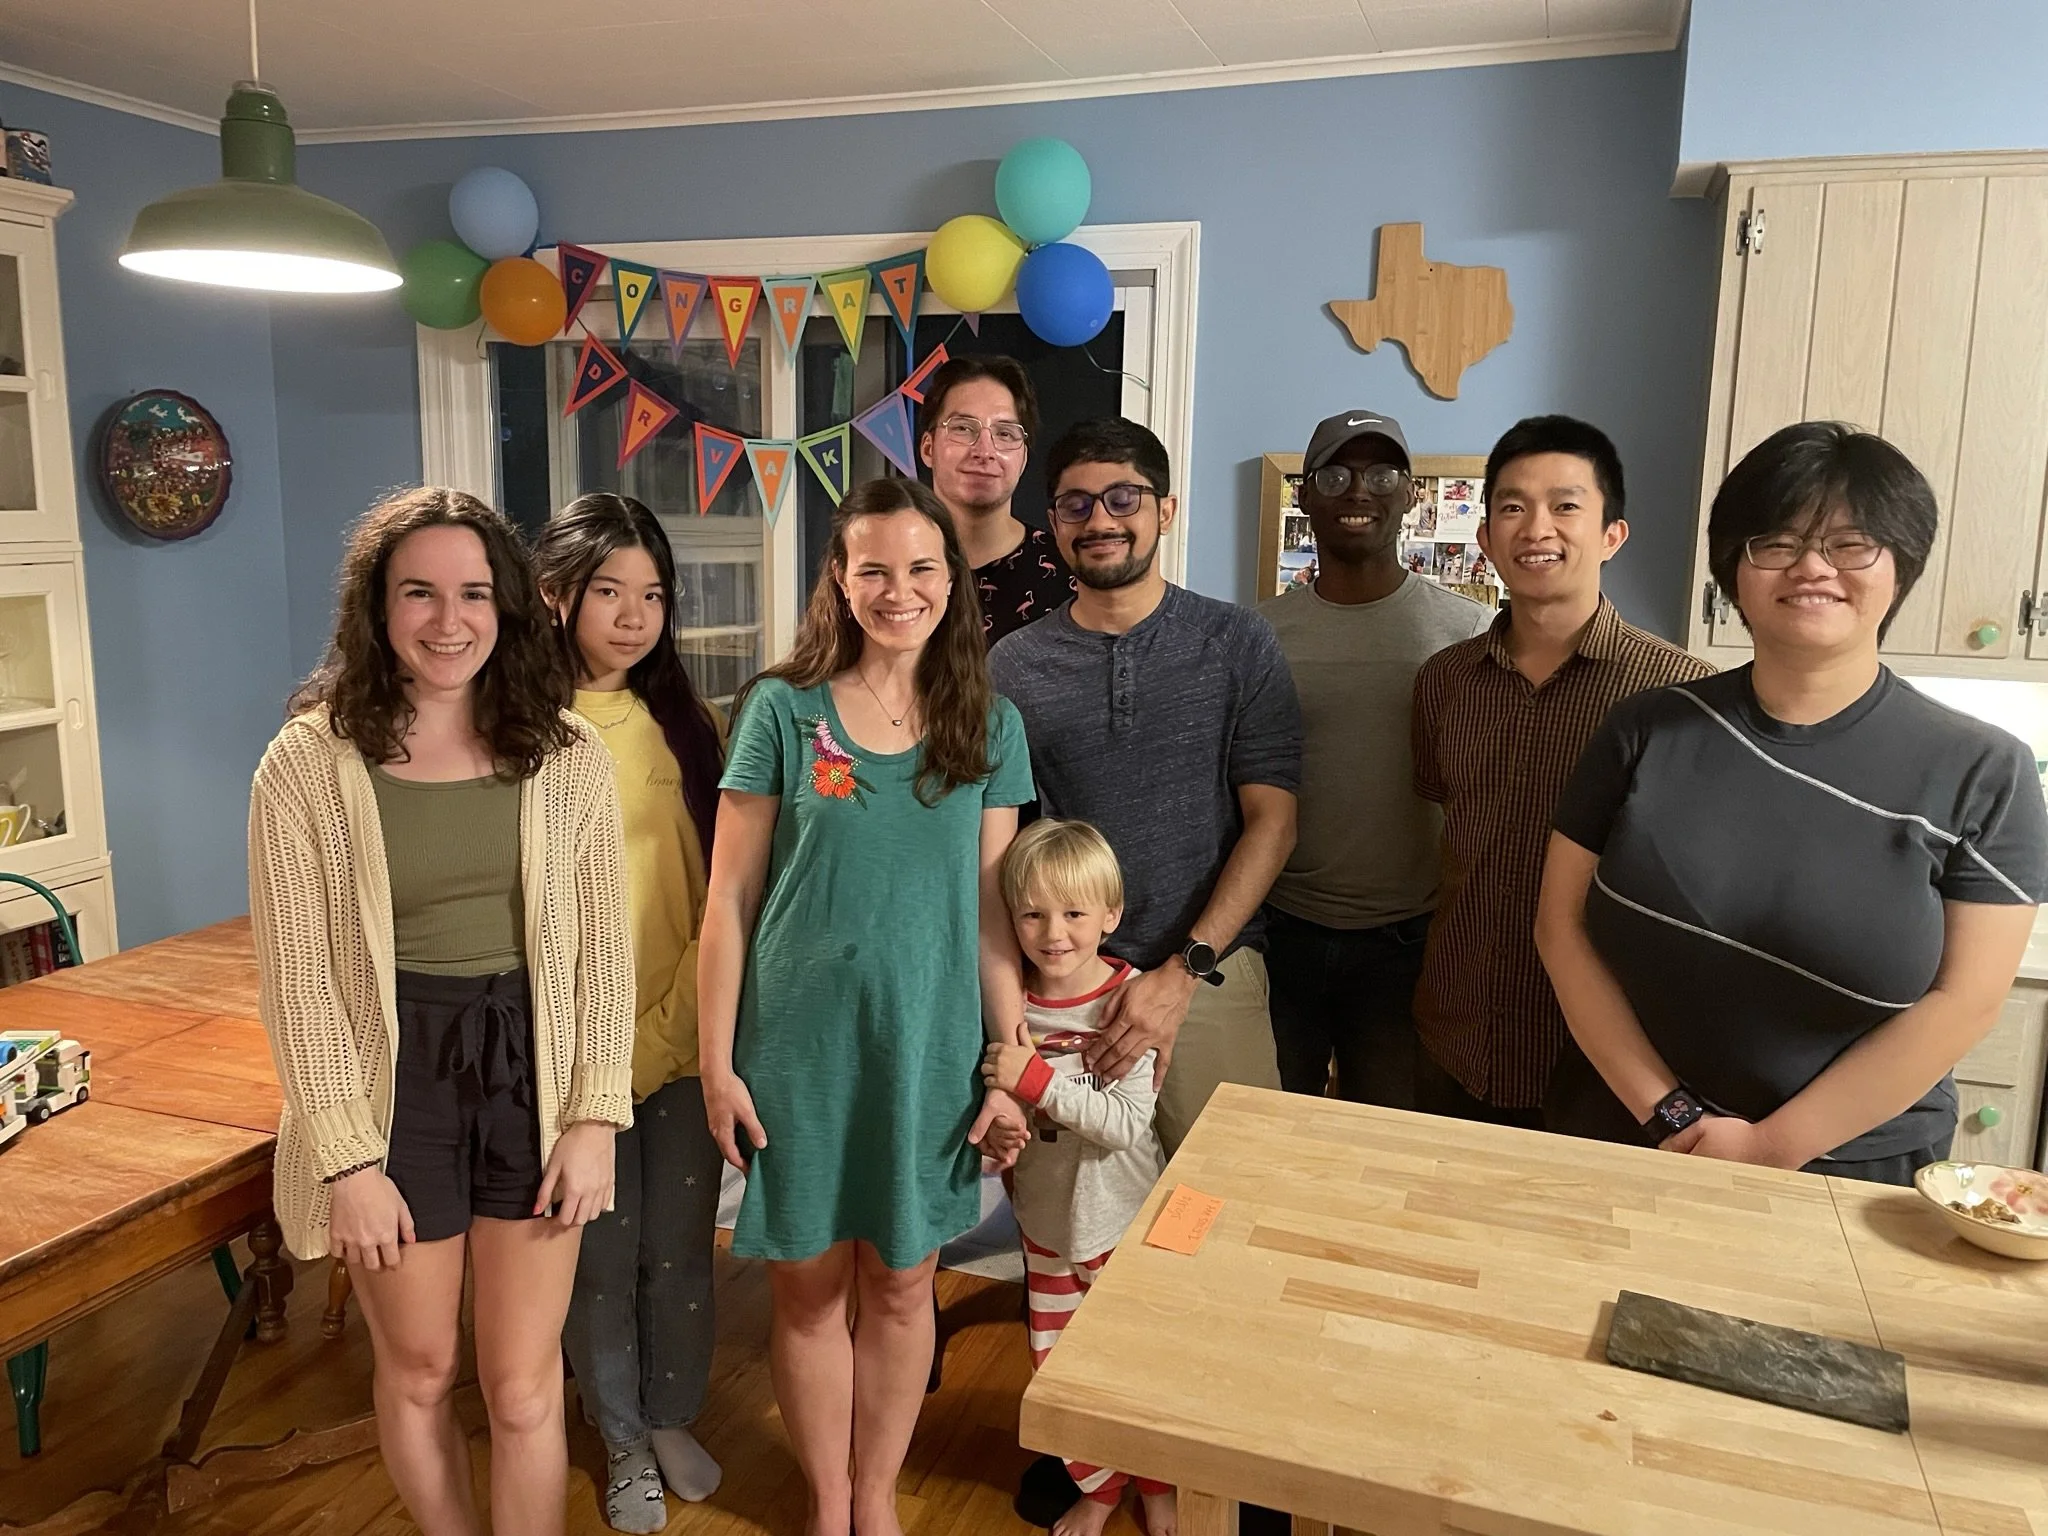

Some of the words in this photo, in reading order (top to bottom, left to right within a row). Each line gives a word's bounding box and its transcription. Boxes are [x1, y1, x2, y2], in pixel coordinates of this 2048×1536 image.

[571, 267, 908, 316] CONGRAT
[587, 366, 652, 428] DR
[709, 422, 895, 477] VAKI
